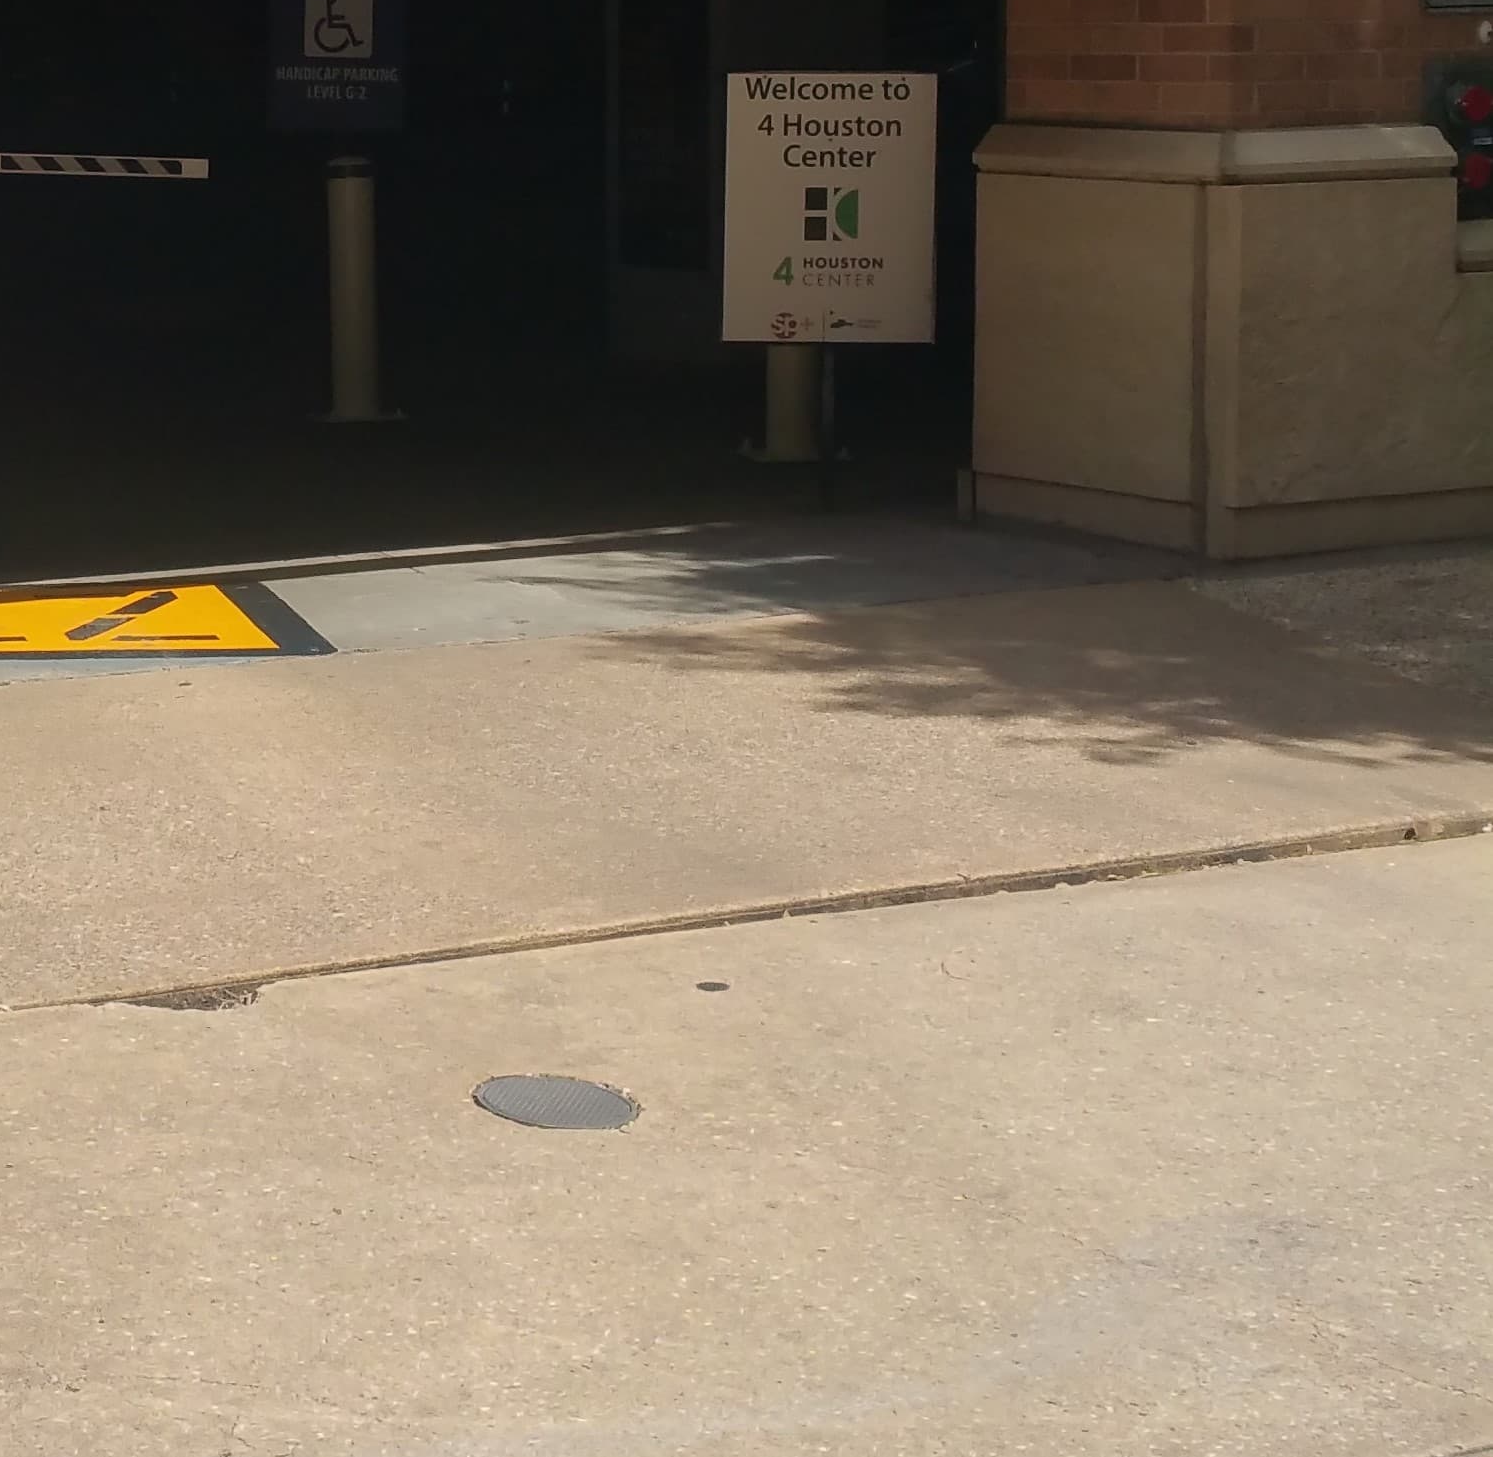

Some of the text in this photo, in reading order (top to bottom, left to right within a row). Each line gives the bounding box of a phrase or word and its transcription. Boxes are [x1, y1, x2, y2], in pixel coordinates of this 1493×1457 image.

[275, 65, 399, 82] HANDICAP PARKING
[307, 85, 343, 100] LEVEL
[745, 76, 911, 100] Welcome to
[757, 114, 902, 137] 4 Houston
[783, 145, 877, 168] Center
[772, 257, 795, 286] 4
[803, 257, 883, 270] HOUSTON
[802, 273, 875, 287] CENTER
